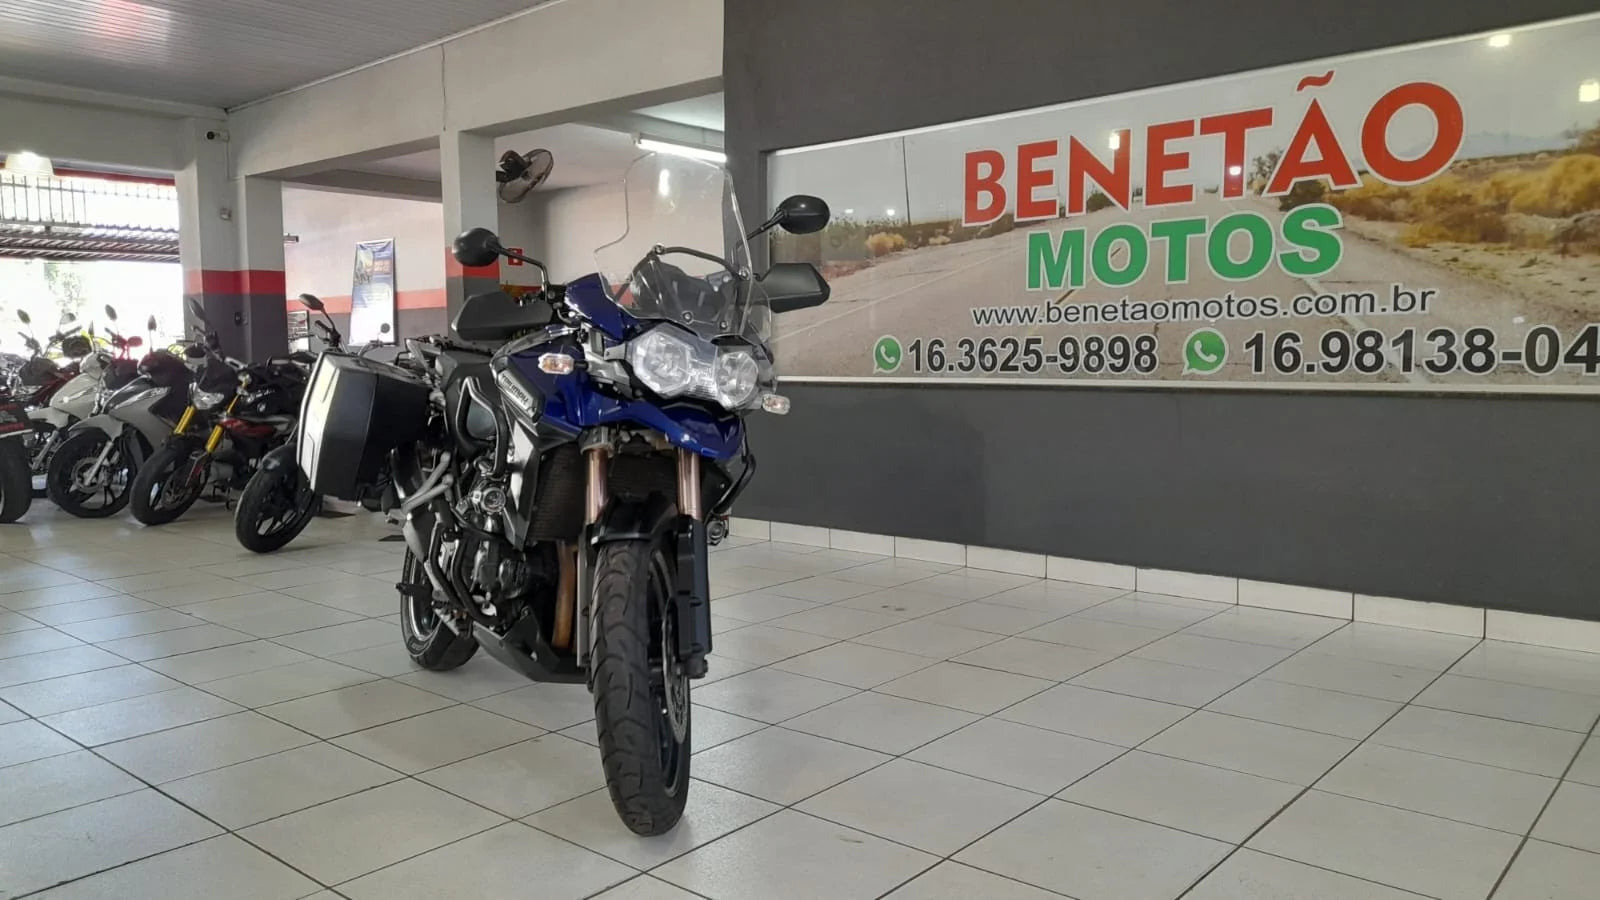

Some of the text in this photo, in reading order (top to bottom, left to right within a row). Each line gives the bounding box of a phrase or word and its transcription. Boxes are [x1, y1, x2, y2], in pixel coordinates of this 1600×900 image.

[964, 71, 1464, 224] BENETÃO
[1028, 206, 1342, 288] MOTOS
[972, 285, 1436, 325] www.benetaomotos.com.br
[909, 326, 1600, 375] 16.3625-9898 16.98138-04
